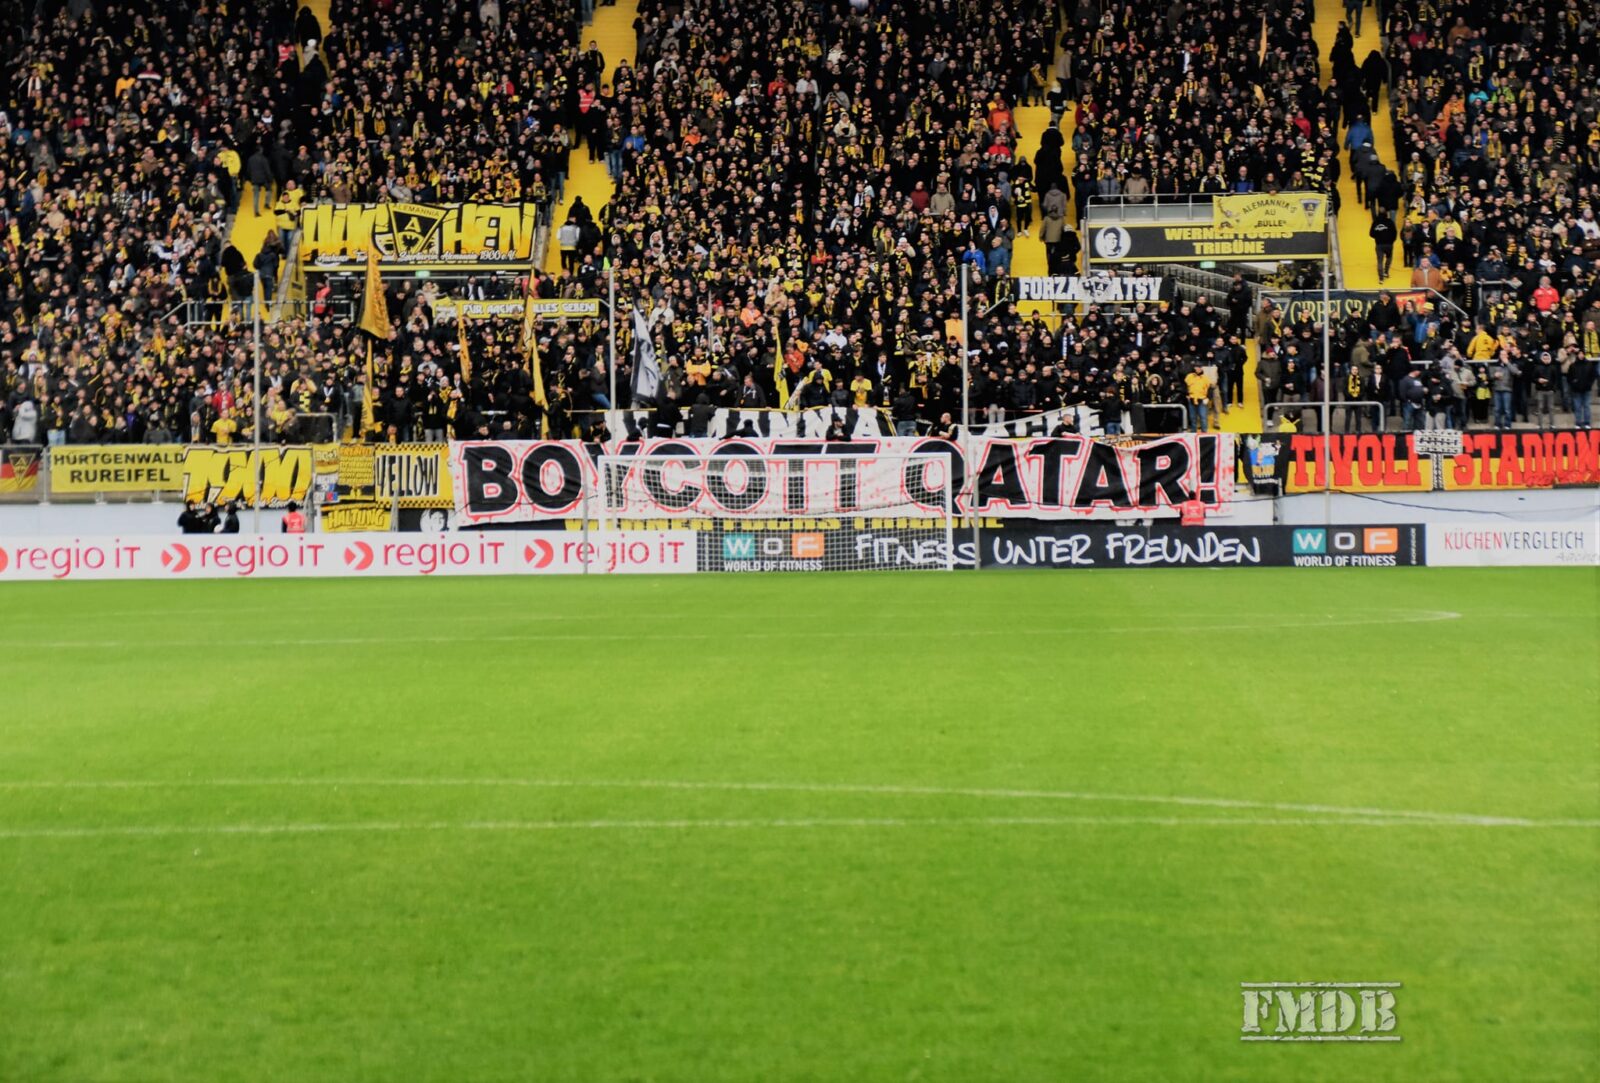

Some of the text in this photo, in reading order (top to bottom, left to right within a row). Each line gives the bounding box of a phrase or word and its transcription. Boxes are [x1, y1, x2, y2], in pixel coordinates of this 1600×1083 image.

[1192, 239, 1265, 255] TRIBÜNE
[1019, 277, 1162, 300] FORZA ATSV
[463, 303, 483, 315] FÜR
[54, 451, 184, 465] HÜRTGENWALD
[1291, 434, 1421, 486] TIVOLI
[1453, 430, 1600, 485] STADION
[70, 468, 170, 483] RUREIFEL
[376, 454, 439, 497] YELLOW
[459, 439, 881, 516] BOYCOTT
[904, 434, 1220, 517] QATAR!
[328, 509, 385, 529] HALTUNG
[855, 532, 1260, 565] FITNESS UNTER FREUNDEN
[1444, 528, 1584, 550] KÜCHENVERGLEICH
[16, 538, 105, 578] regio
[202, 537, 289, 575] regio
[384, 535, 471, 574] regio
[562, 534, 650, 573] regio
[1294, 555, 1396, 567] WORLD OF FITNESS
[724, 561, 823, 572] WORLD OF FITNESS
